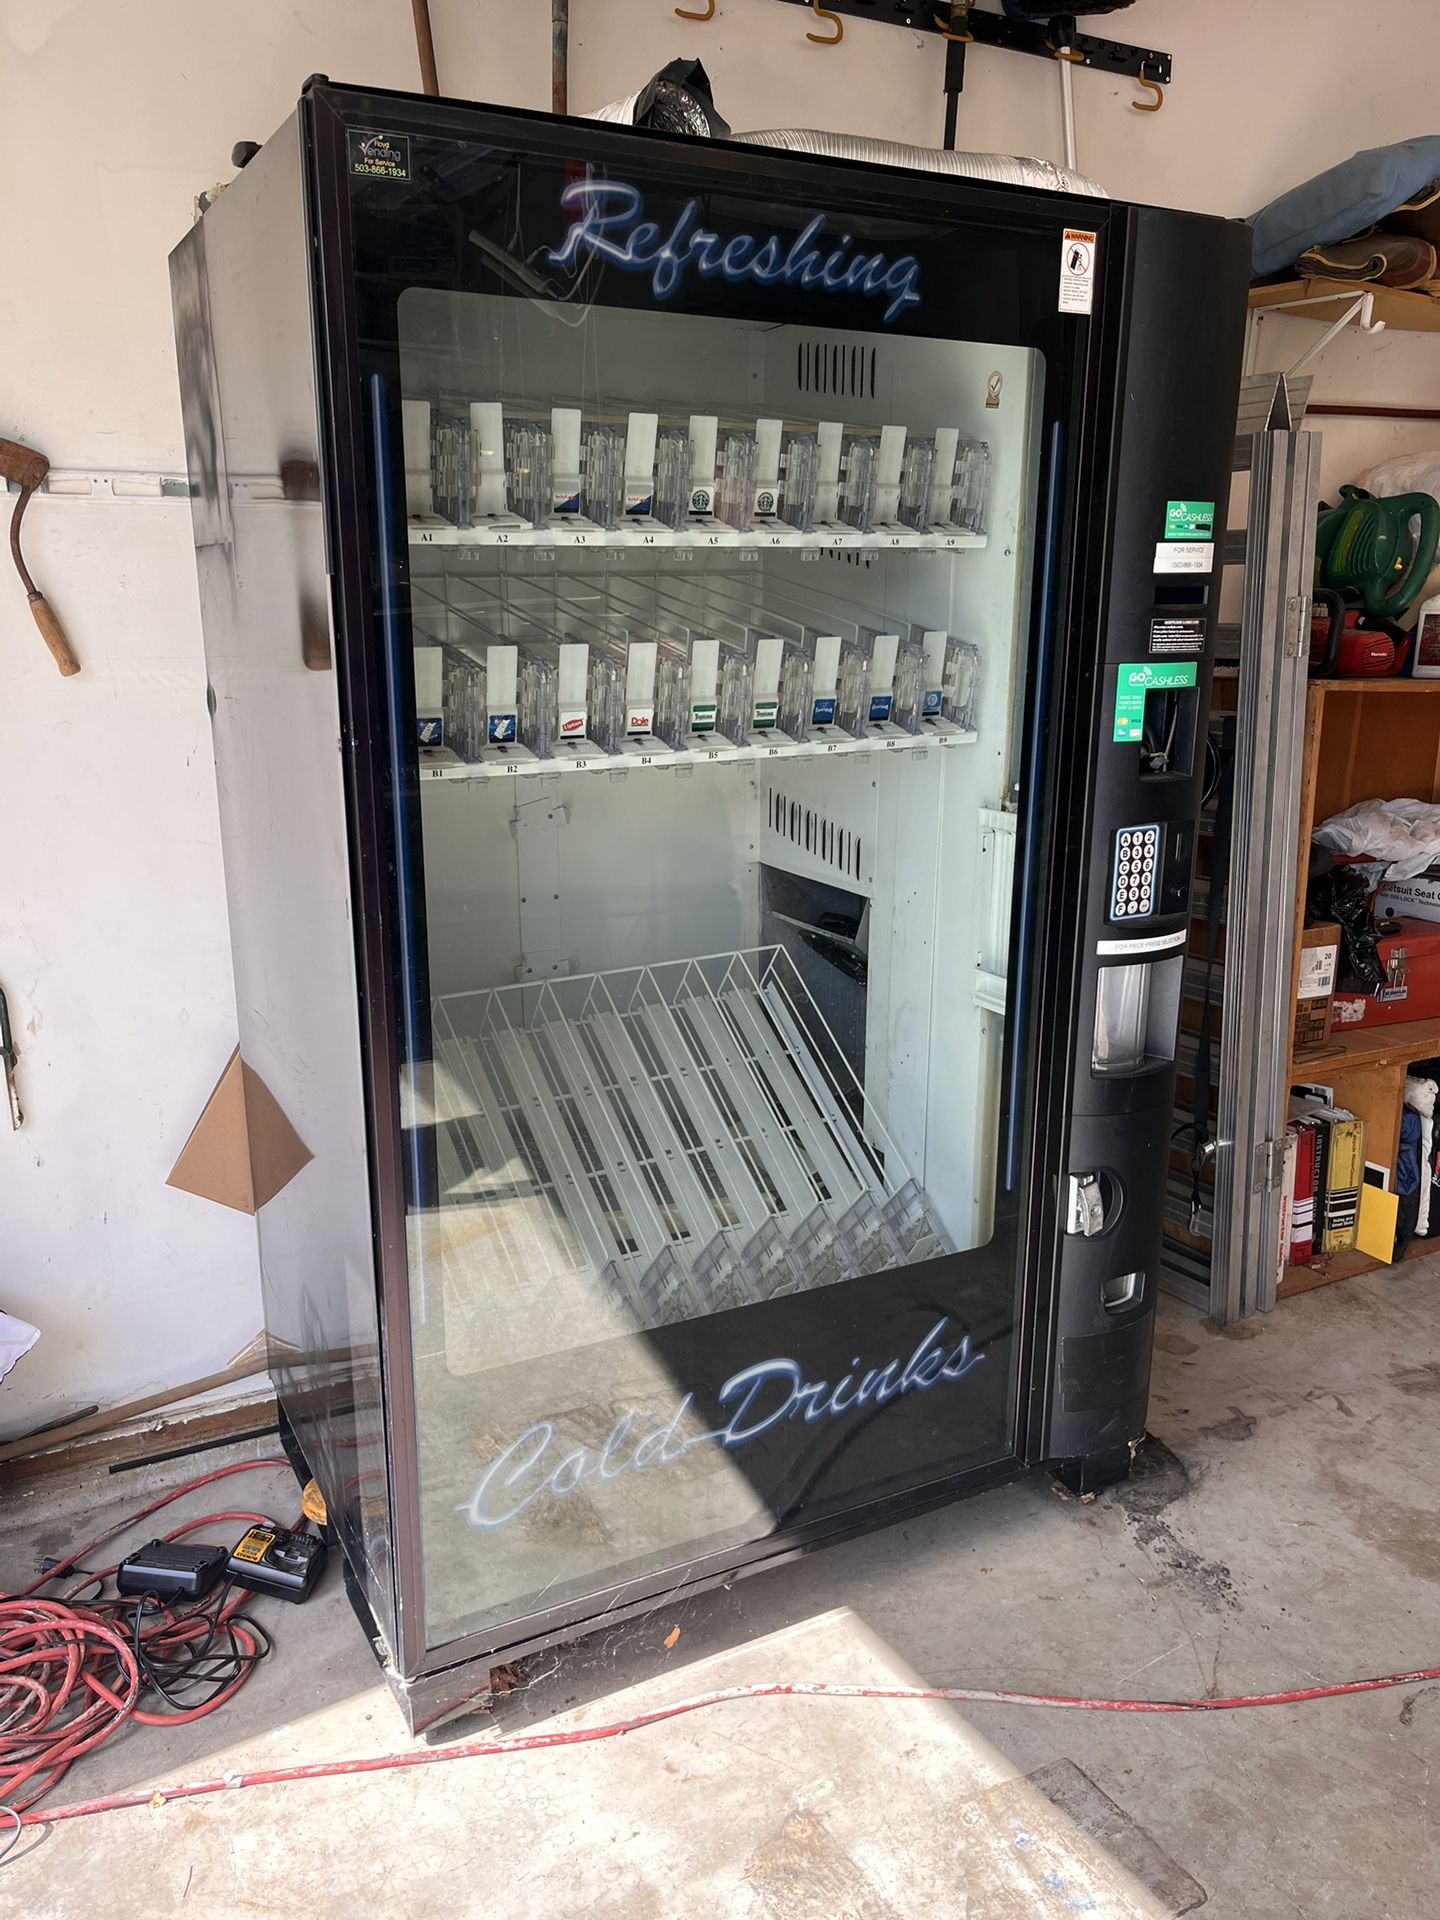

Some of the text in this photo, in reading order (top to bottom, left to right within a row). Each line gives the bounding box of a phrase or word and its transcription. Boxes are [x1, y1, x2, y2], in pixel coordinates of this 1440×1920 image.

[375, 158, 396, 167] Service
[354, 163, 406, 177] 503-866-1934
[548, 178, 920, 321] Refreshing
[1169, 508, 1213, 522] GO CASHLESS
[421, 533, 956, 546] A1 A2 A3 A4 A5 A6 A7 A8 A9
[1129, 672, 1188, 686] GO CASHLESS
[631, 717, 649, 726] Dole
[1414, 888, 1435, 900] Seat
[1313, 1134, 1323, 1192] INSTRUCTOR
[1280, 1194, 1288, 1240] Instructor
[455, 1317, 986, 1528] Cold Drinks
